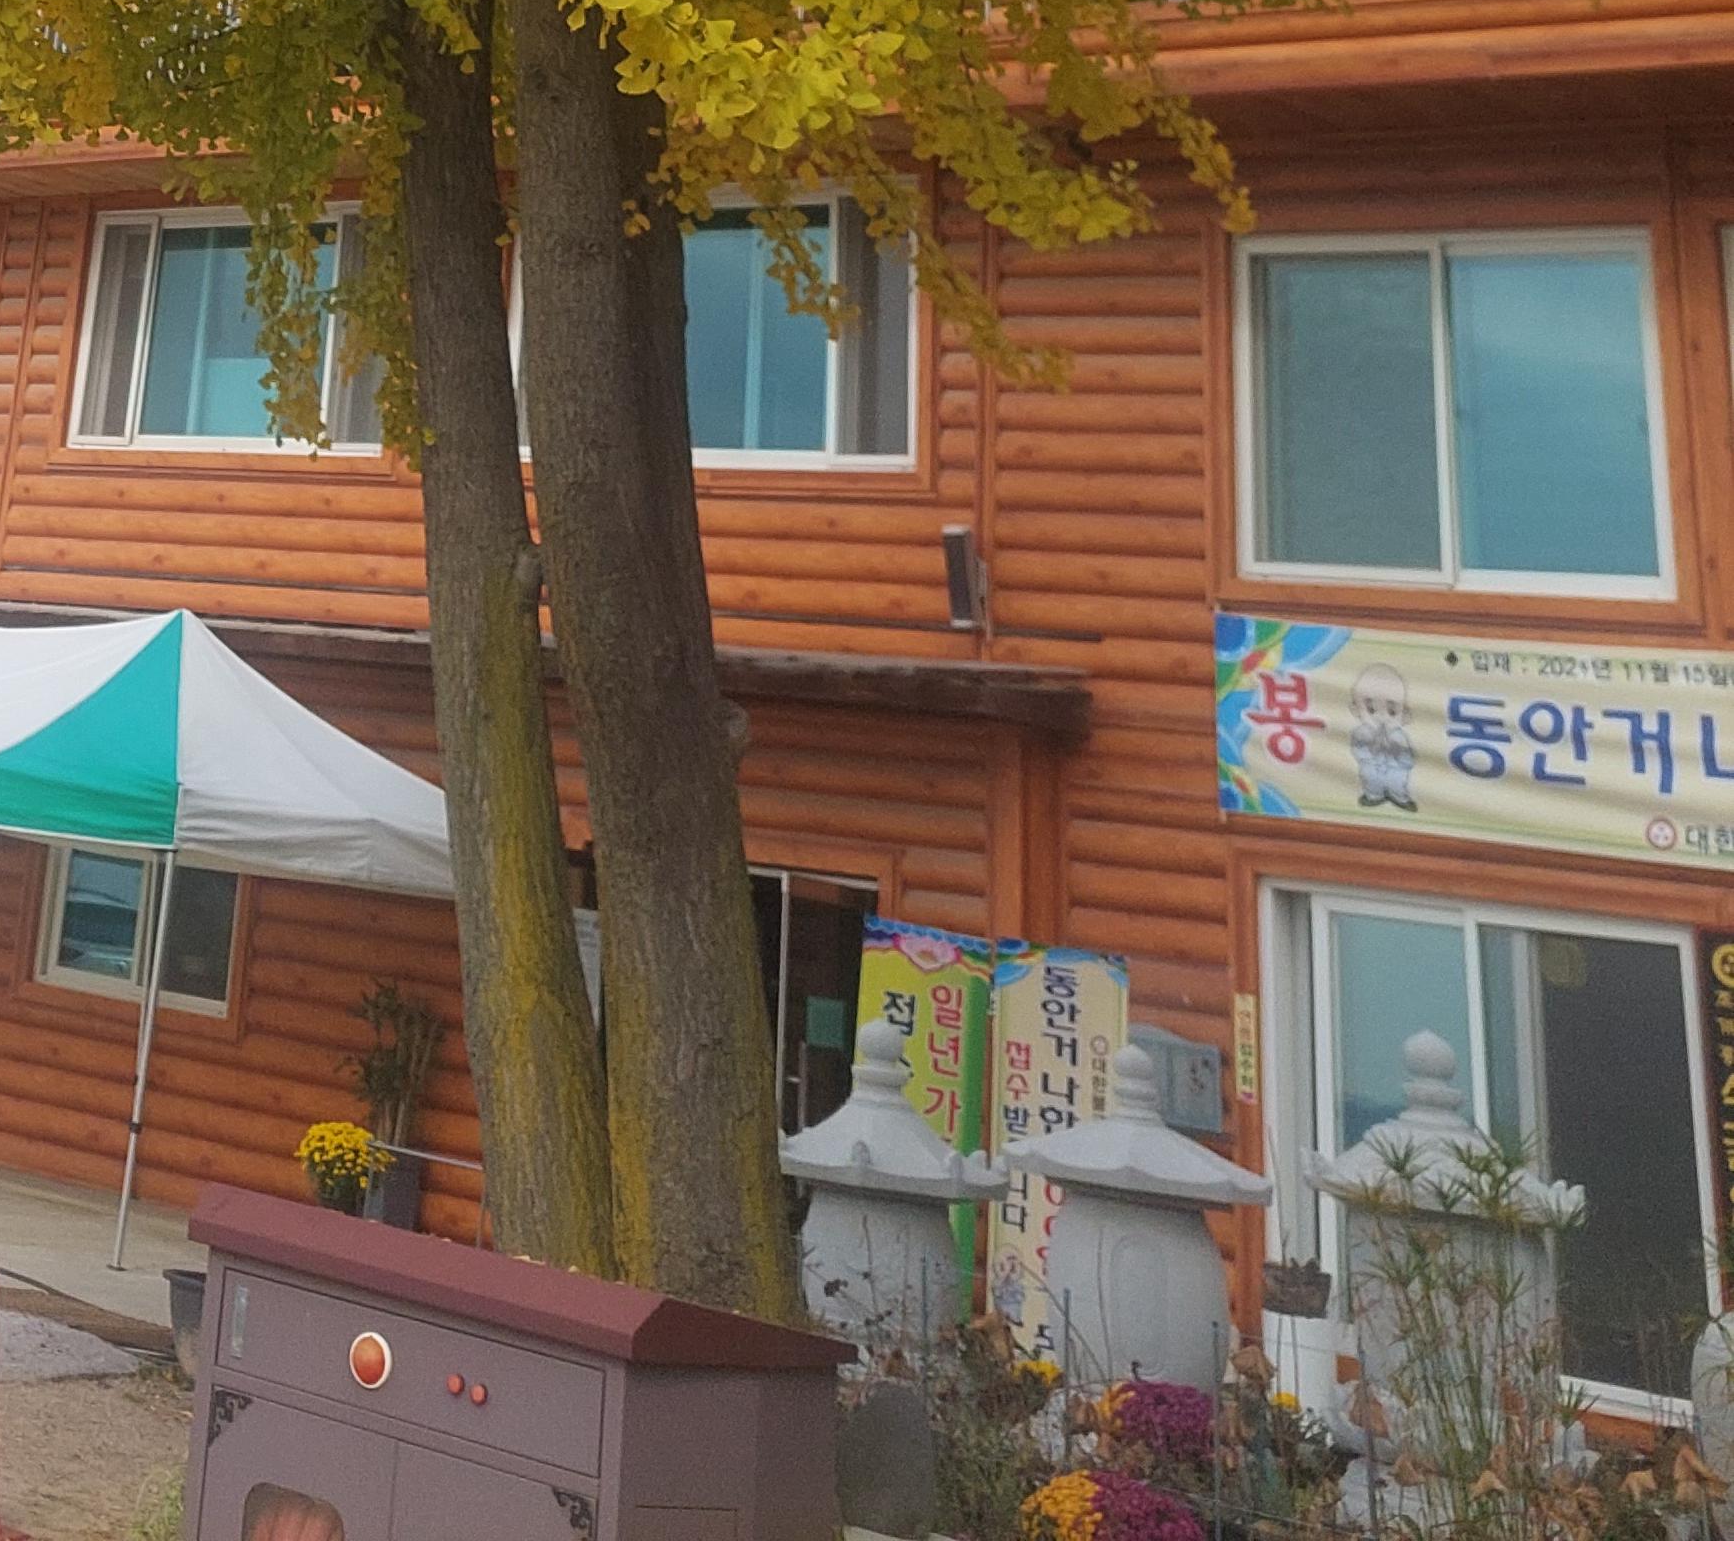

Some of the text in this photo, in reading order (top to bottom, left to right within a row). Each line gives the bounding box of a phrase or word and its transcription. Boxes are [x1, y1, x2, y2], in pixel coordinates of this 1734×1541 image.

[1245, 670, 1326, 764] 봉
[1447, 695, 1674, 795] 동안거
[1041, 966, 1082, 1067] 동안거
